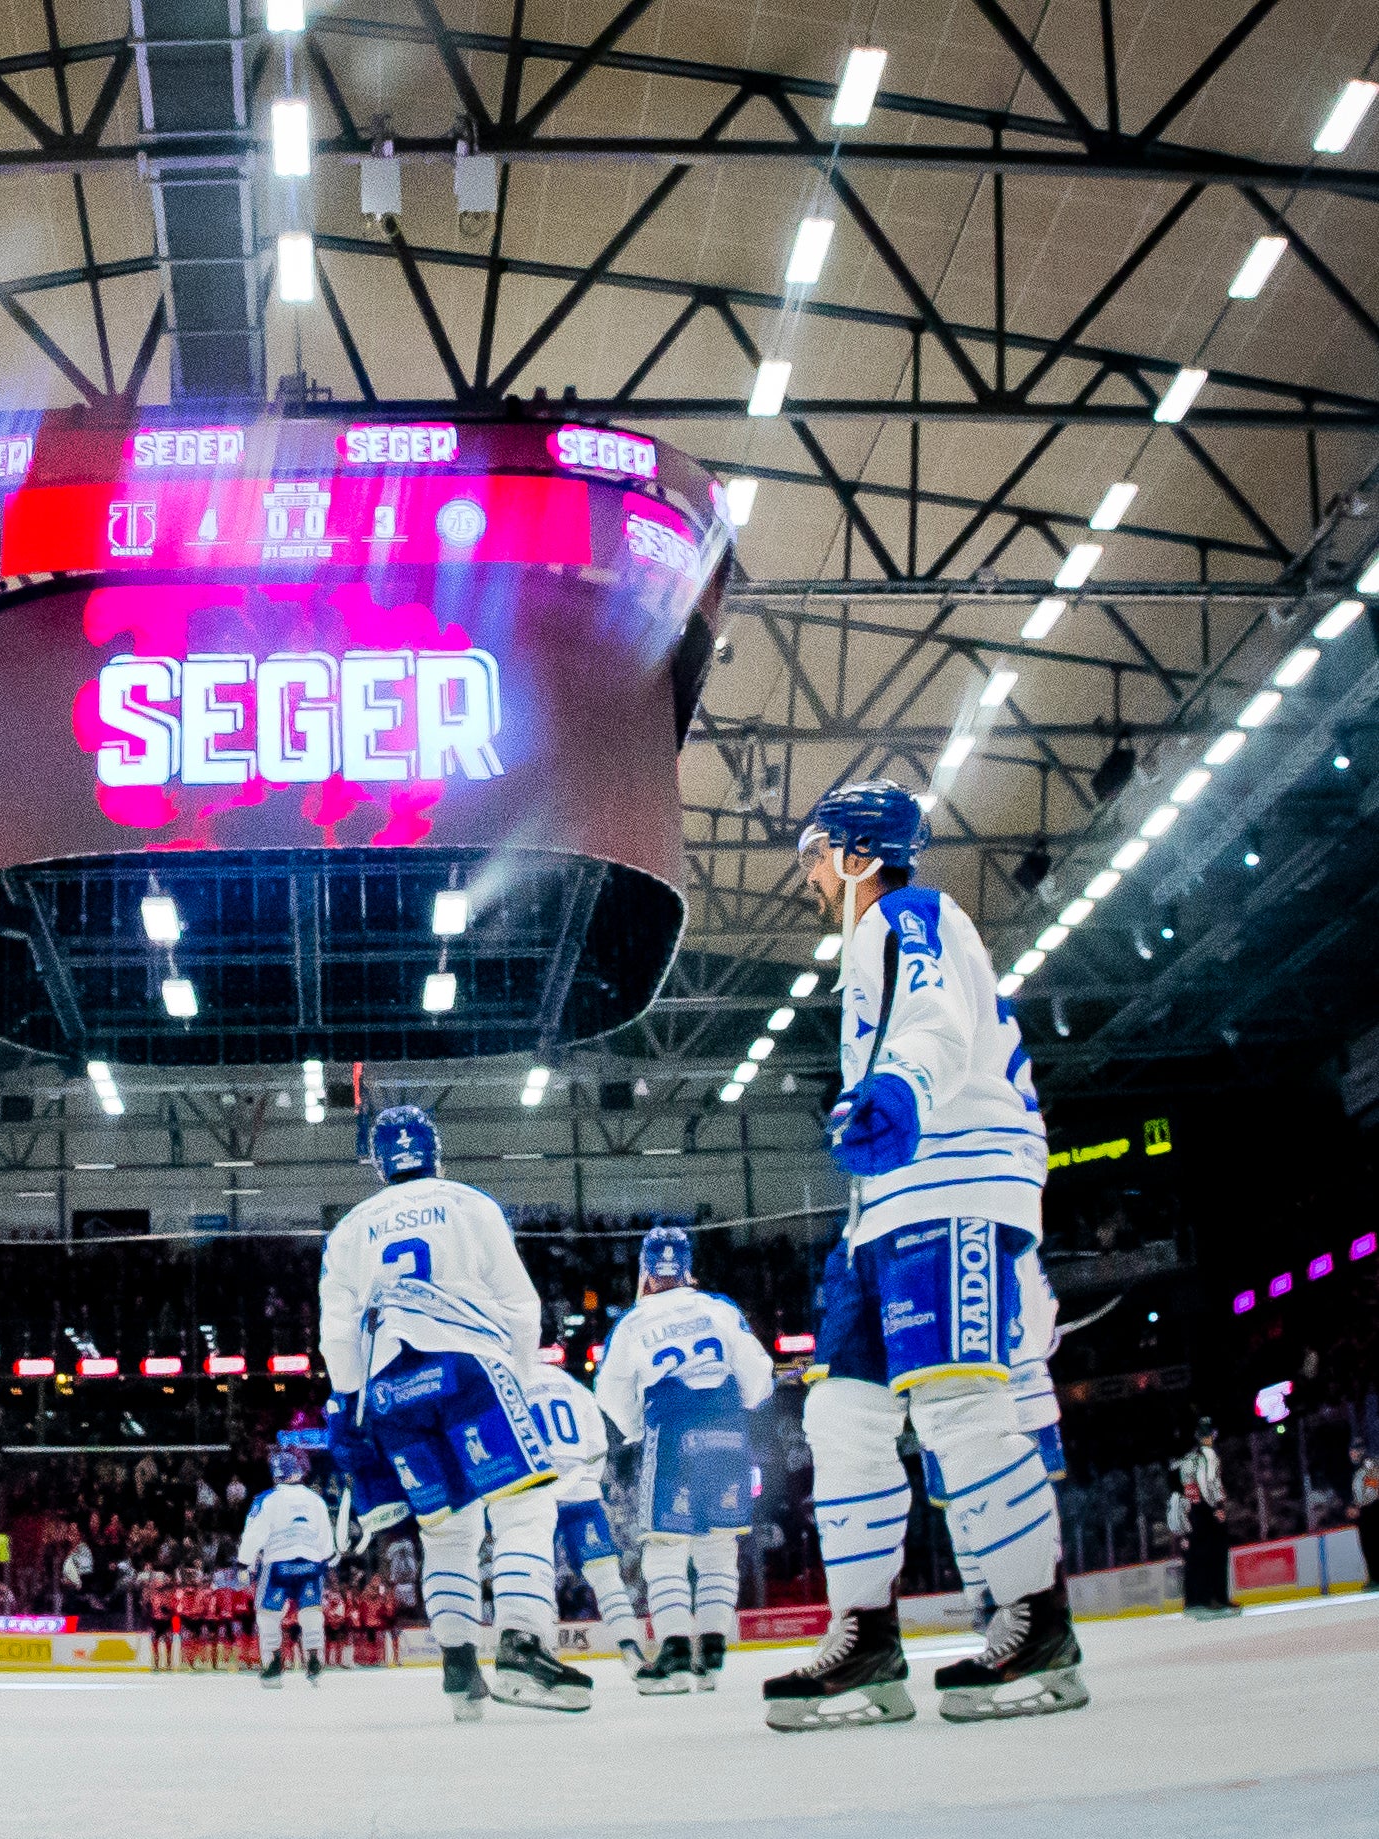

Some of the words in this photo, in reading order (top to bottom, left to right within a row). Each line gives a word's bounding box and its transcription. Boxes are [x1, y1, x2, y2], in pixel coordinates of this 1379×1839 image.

[133, 430, 245, 467] SEGER
[345, 426, 458, 463] SEGER
[557, 427, 657, 478] SEGER
[197, 507, 219, 541] 4
[374, 506, 396, 539] 3
[97, 648, 507, 787] SEGER
[368, 1205, 447, 1245] NILSSON
[960, 1218, 989, 1354] RADON
